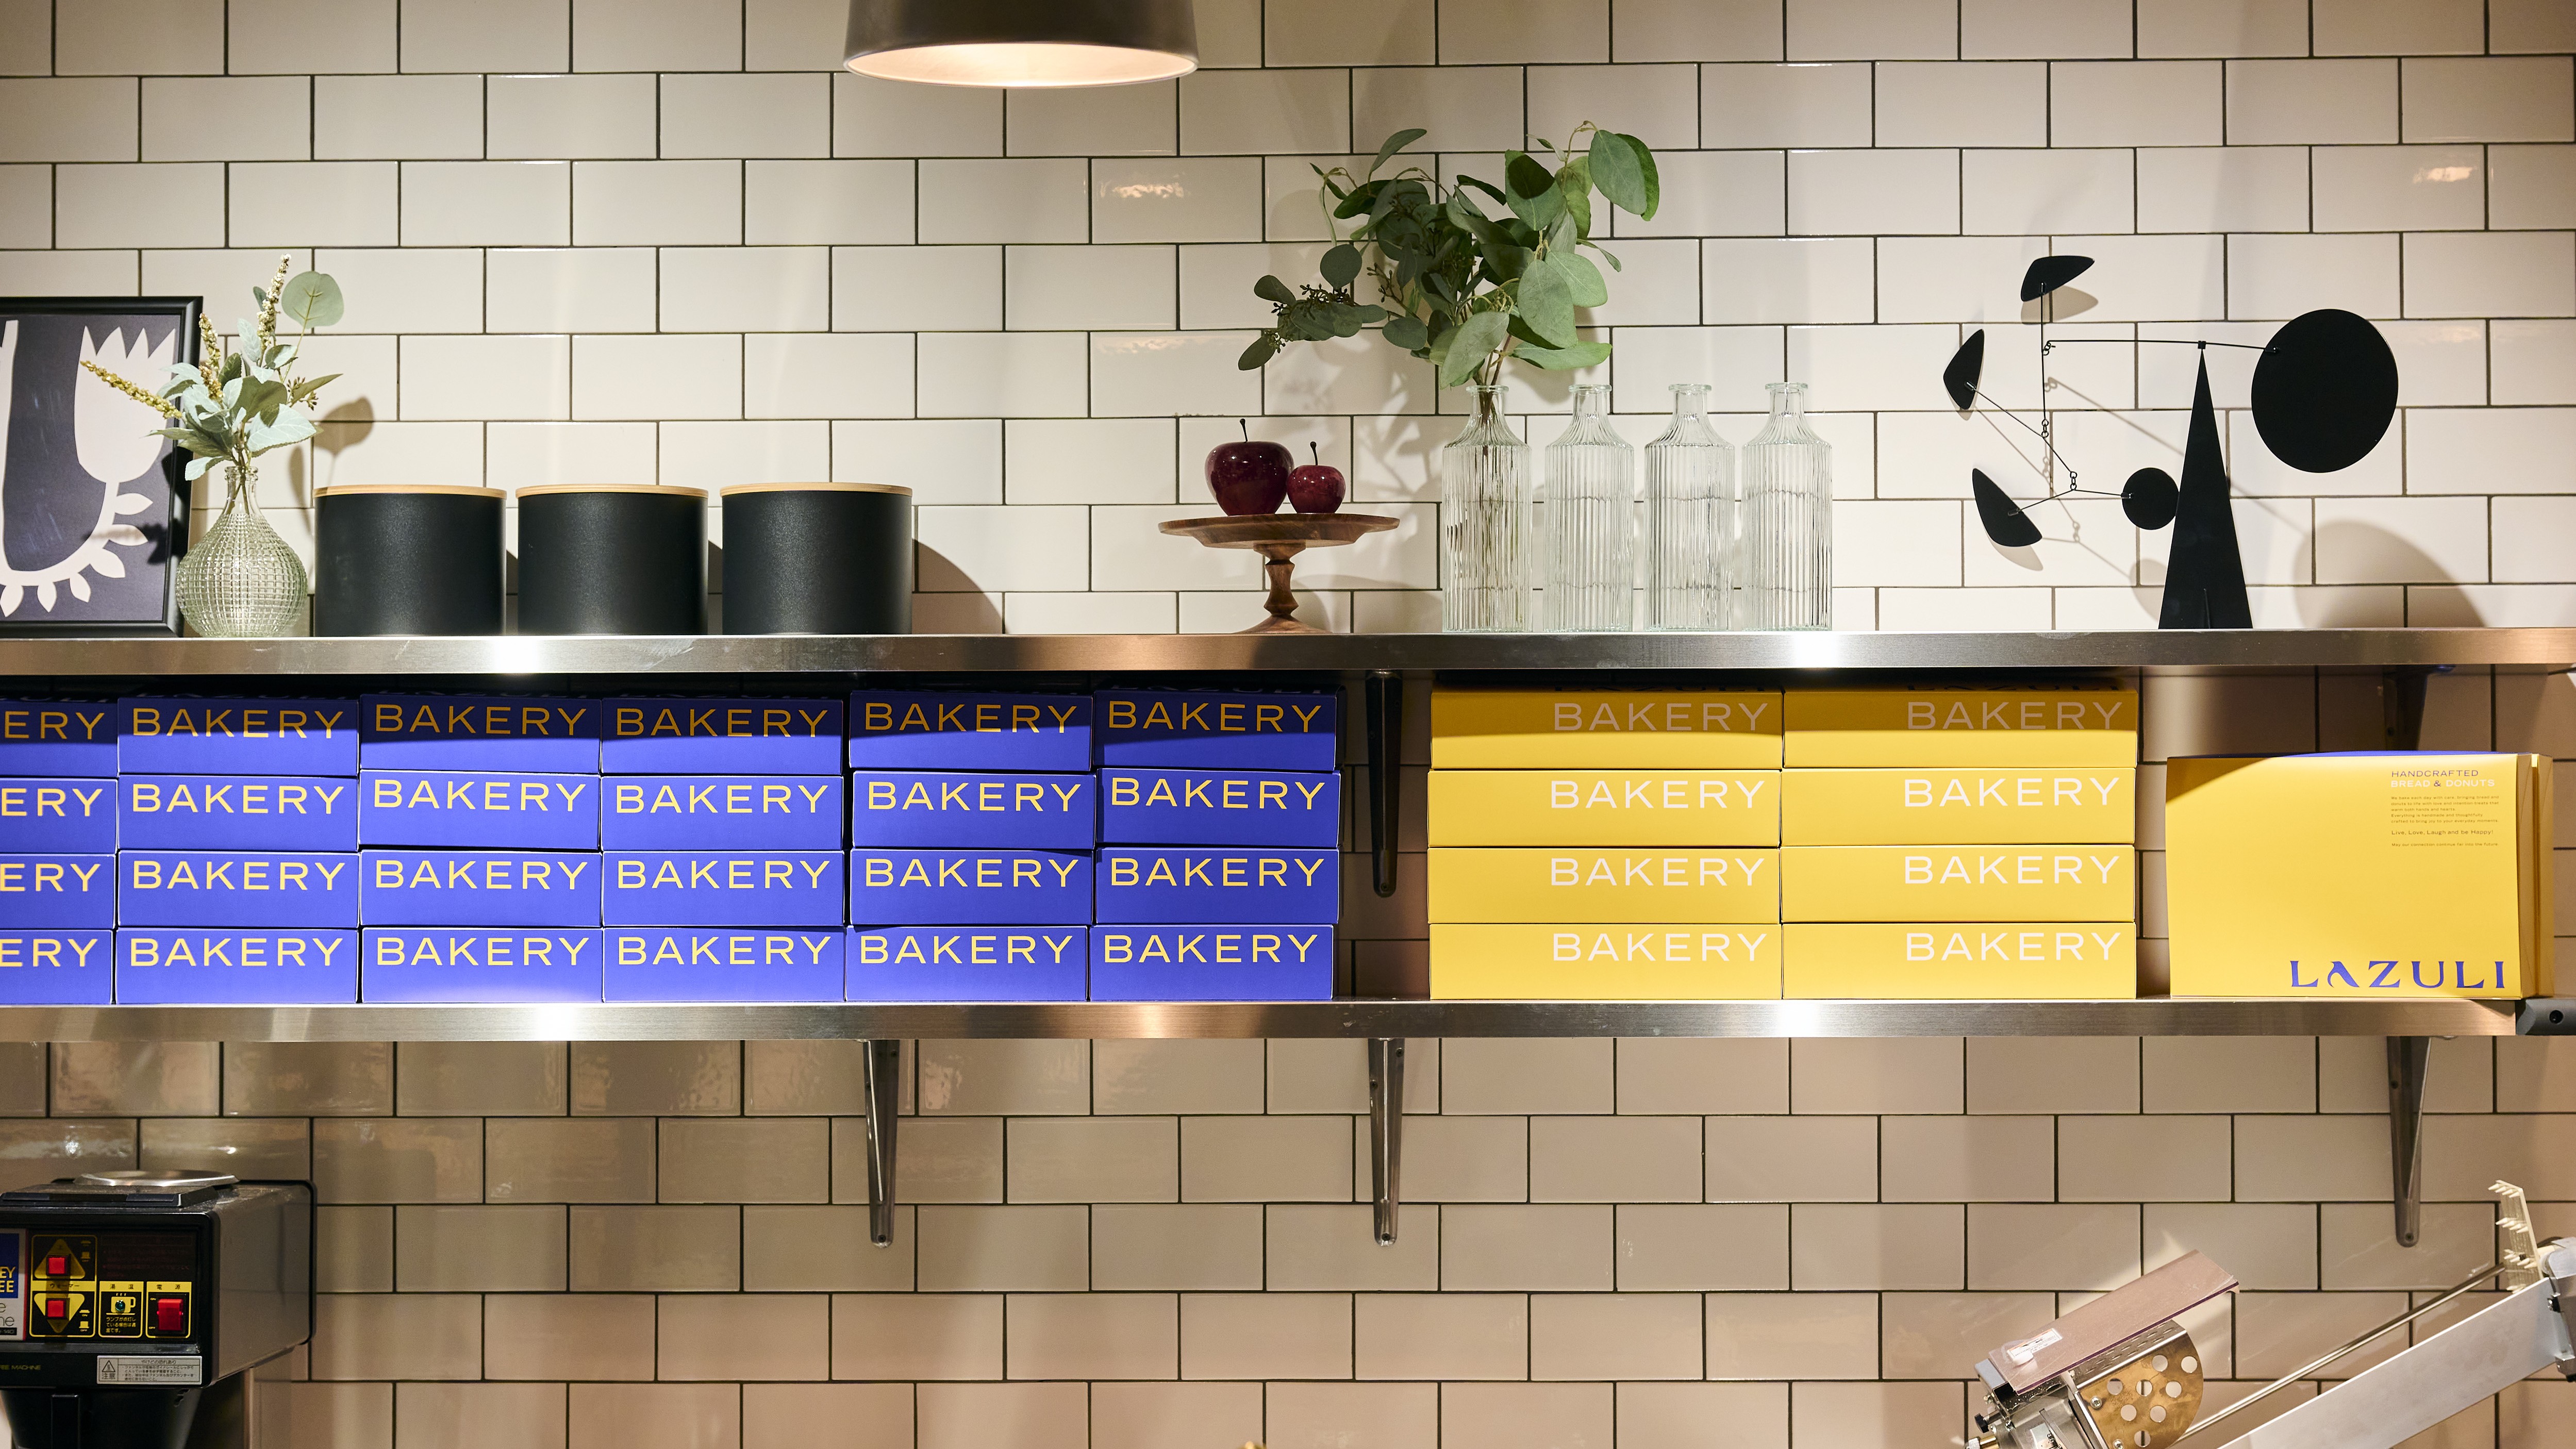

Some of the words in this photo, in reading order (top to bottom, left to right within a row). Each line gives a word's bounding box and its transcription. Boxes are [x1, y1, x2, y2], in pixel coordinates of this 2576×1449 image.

[133, 708, 343, 739] BAKERY
[376, 704, 586, 736] BAKERY
[617, 708, 827, 737] BAKERY
[866, 703, 1076, 733] BAKERY
[1109, 701, 1321, 733] BAKERY
[1554, 703, 1768, 731] BAKERY
[1907, 702, 2122, 730] BAKERY
[133, 785, 343, 814] BAKERY
[374, 780, 585, 811] BAKERY
[617, 785, 827, 813] BAKERY
[869, 782, 1081, 811] BAKERY
[1111, 778, 1324, 810] BAKERY
[1551, 780, 1765, 809] BAKERY
[1905, 779, 2120, 808] BAKERY
[134, 861, 344, 890] BAKERY
[376, 860, 587, 889] BAKERY
[618, 860, 829, 888] BAKERY
[866, 858, 1078, 887] BAKERY
[1111, 858, 1324, 886] BAKERY
[1551, 858, 1765, 886] BAKERY
[1905, 856, 2120, 885] BAKERY
[131, 938, 342, 966] BAKERY
[377, 938, 588, 965] BAKERY
[619, 937, 830, 964] BAKERY
[861, 936, 1072, 963] BAKERY
[1105, 935, 1317, 963] BAKERY
[1553, 933, 1768, 962] BAKERY
[1906, 932, 2122, 962] BAKERY
[2290, 960, 2505, 989] LAZULI
